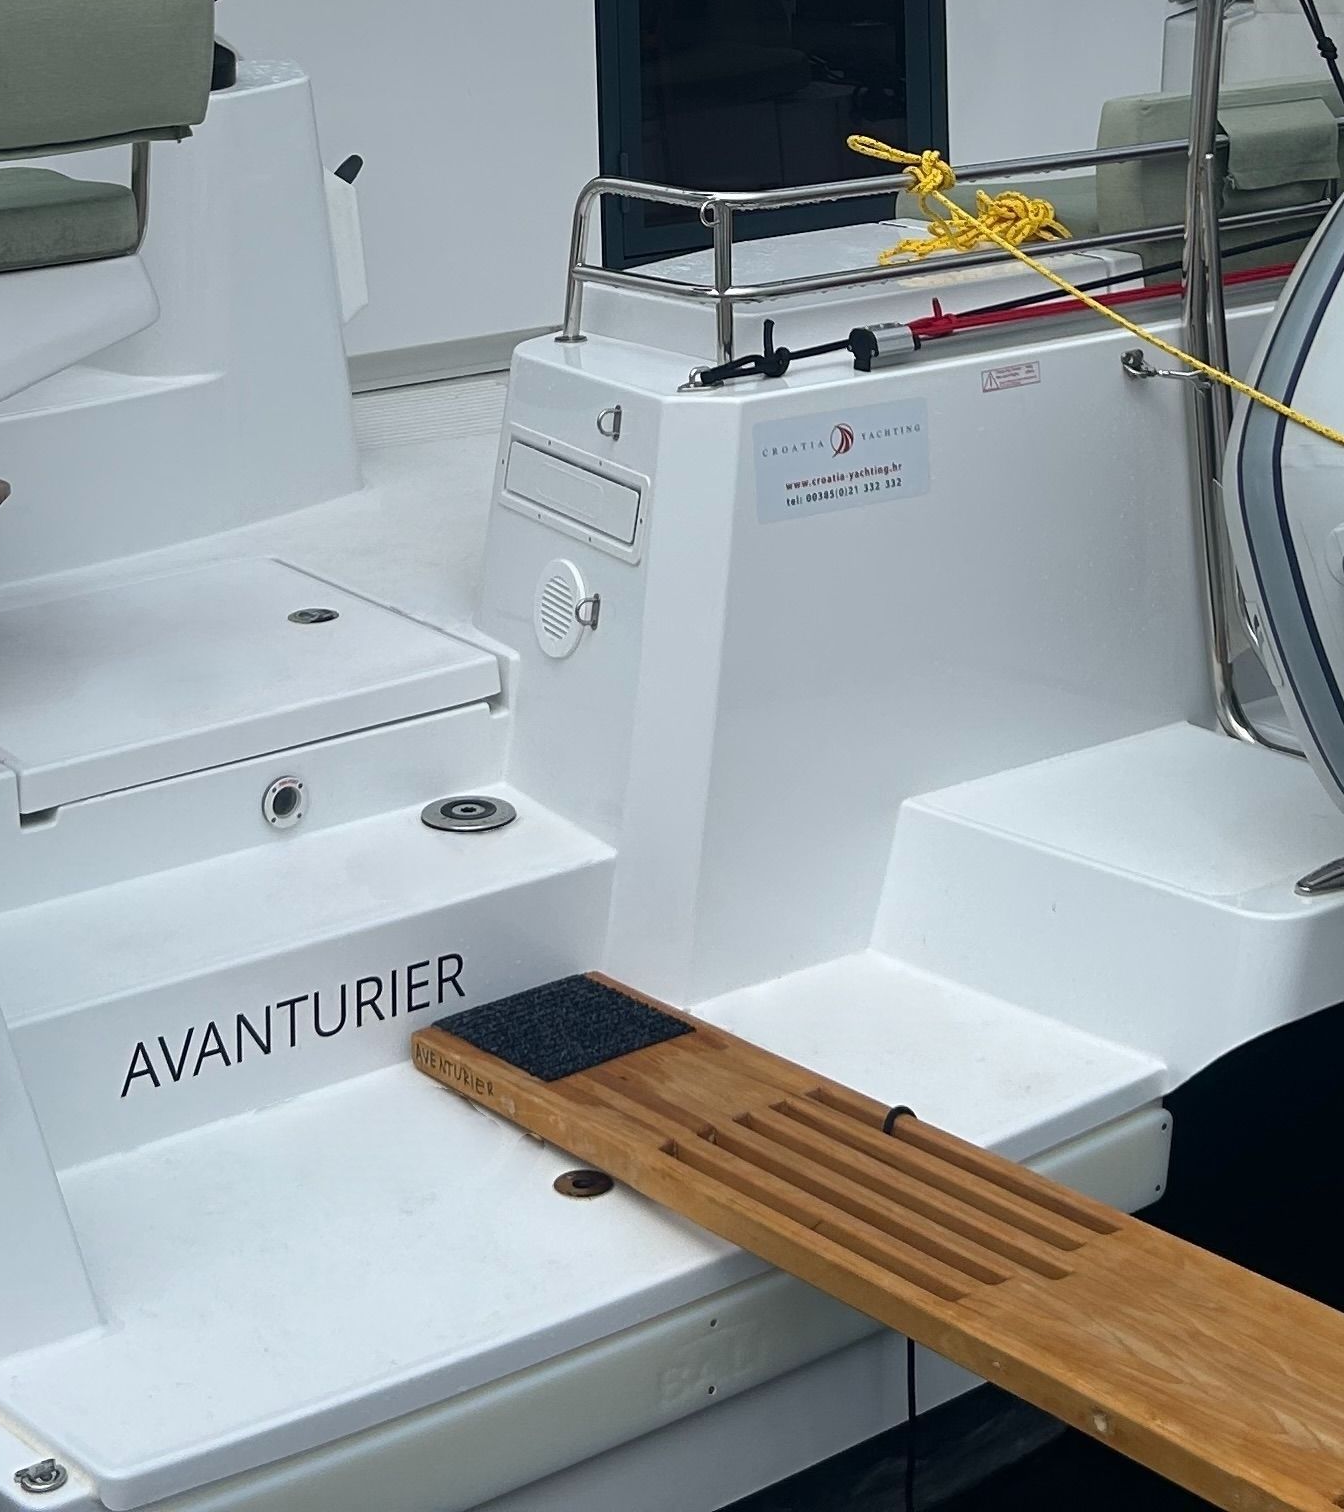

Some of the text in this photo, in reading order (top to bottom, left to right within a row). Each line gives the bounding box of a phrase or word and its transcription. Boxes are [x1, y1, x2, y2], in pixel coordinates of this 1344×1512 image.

[762, 424, 921, 458] CROATIA YACHTING
[785, 462, 903, 491] www.croatia-yachting.hr
[786, 494, 803, 507] tel:
[863, 481, 881, 494] 332
[885, 477, 902, 489] 332
[120, 953, 466, 1098] AVANTURIER
